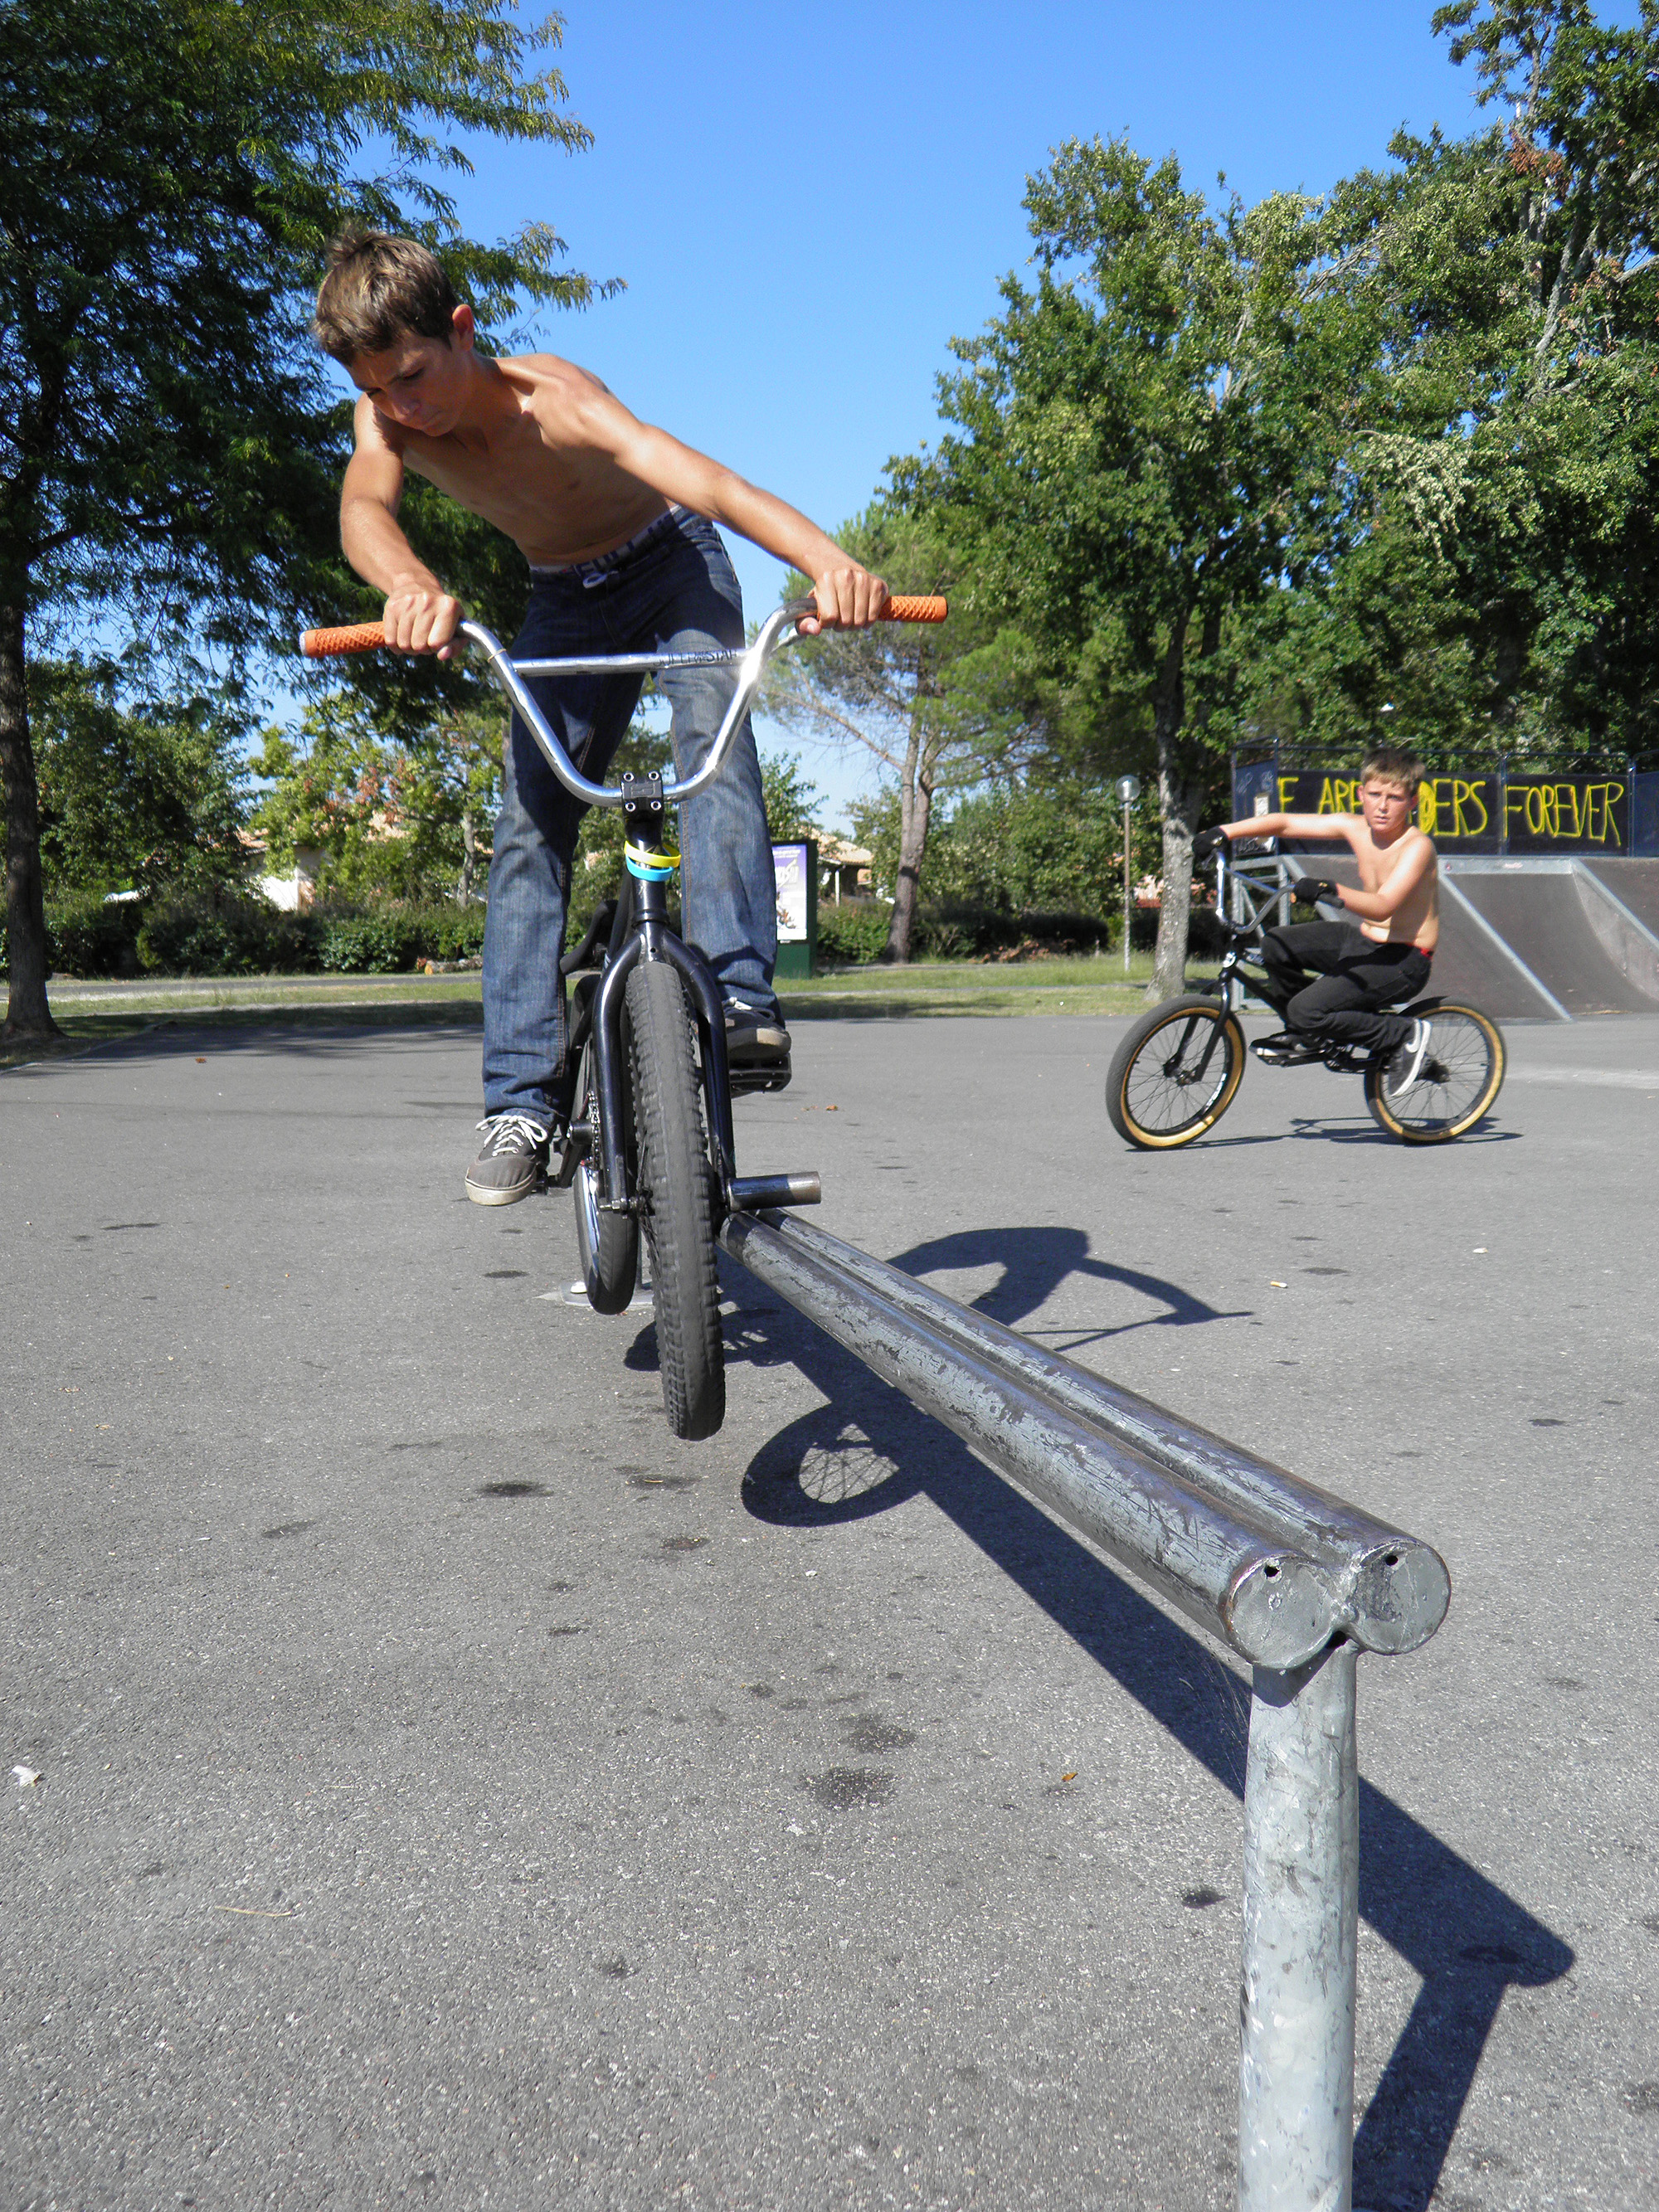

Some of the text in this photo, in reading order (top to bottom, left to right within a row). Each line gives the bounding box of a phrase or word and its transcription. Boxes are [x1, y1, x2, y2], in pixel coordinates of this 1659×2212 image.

[1317, 777, 1363, 814] ARE
[1408, 779, 1488, 835] DERS
[1504, 782, 1624, 846] FOREVER
